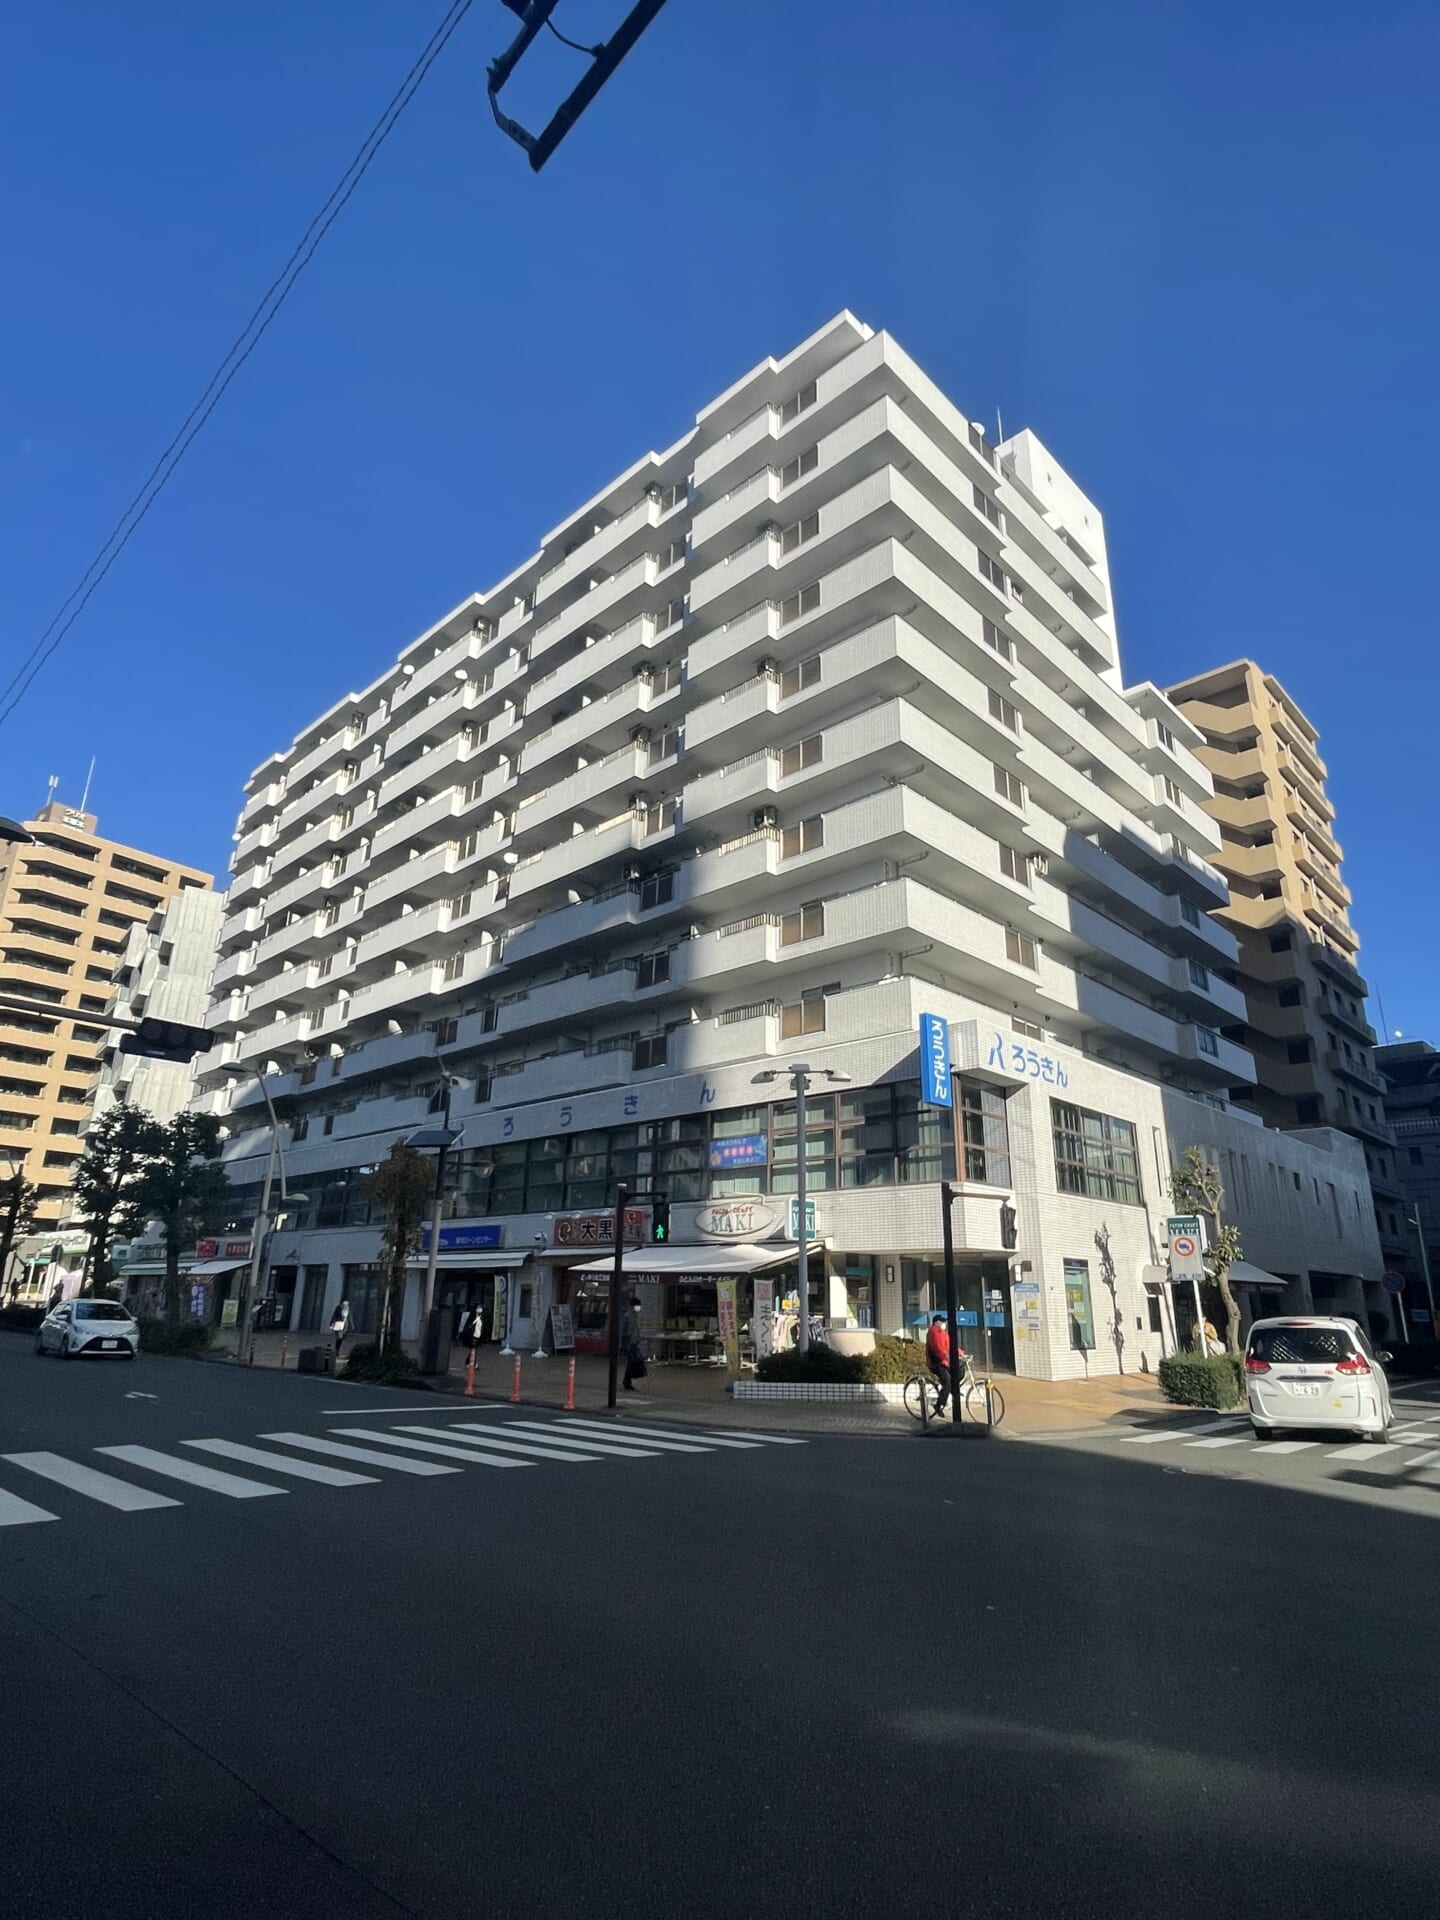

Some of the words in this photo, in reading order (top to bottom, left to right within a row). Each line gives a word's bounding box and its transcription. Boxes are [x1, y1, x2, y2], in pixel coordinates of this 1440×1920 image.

[932, 1020, 946, 1099] ろうきん
[1012, 1045, 1068, 1088] ろうきん
[503, 1080, 717, 1136] ろうきん
[579, 1217, 613, 1241] 大黒
[711, 1214, 754, 1232] MAKI
[793, 1213, 815, 1231] MKI
[638, 1275, 661, 1284] MAKI
